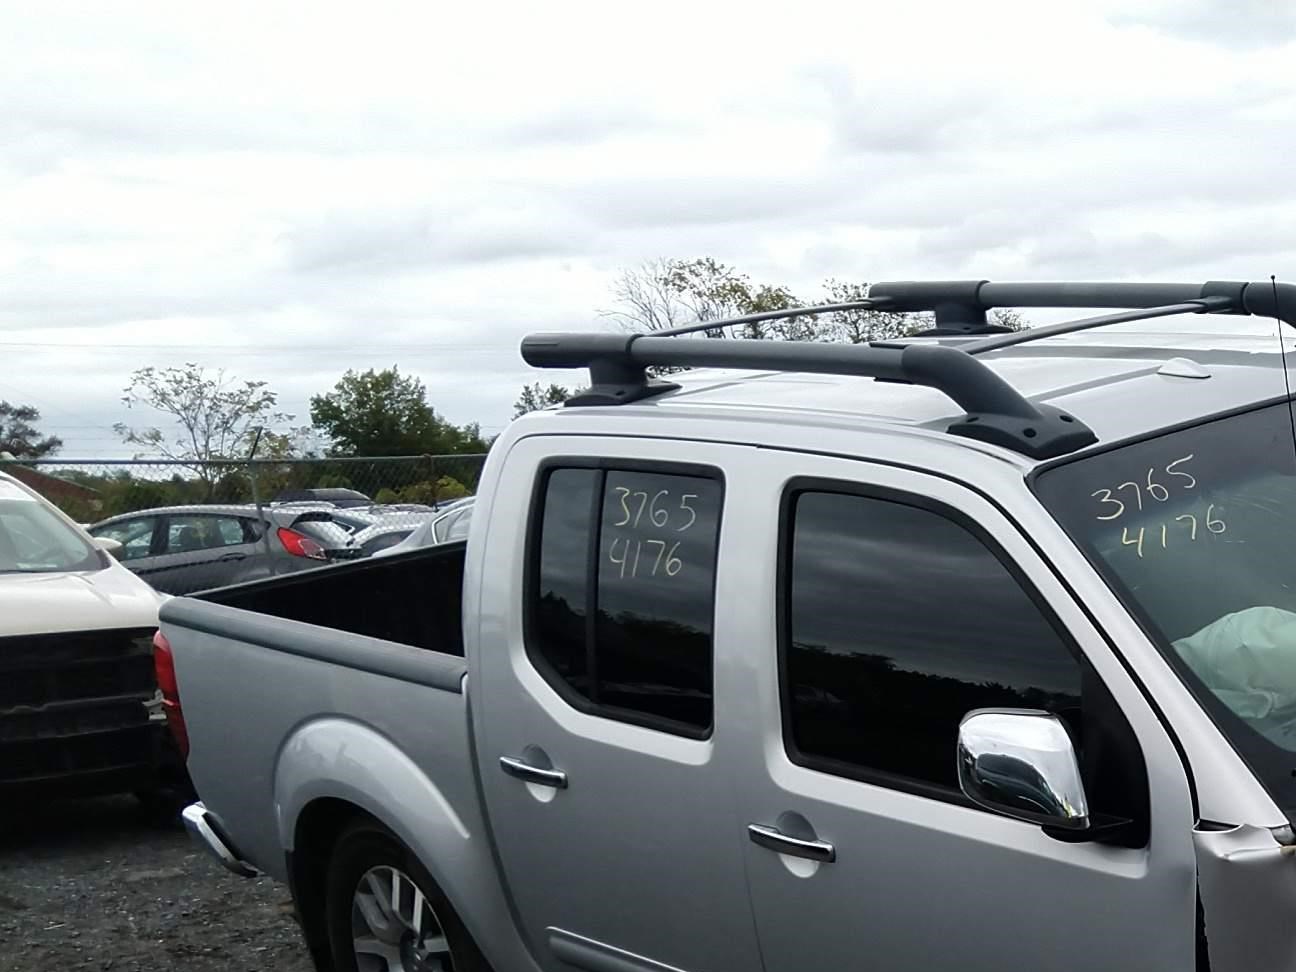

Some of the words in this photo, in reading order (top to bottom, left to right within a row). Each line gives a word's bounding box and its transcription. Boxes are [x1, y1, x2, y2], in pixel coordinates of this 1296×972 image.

[614, 486, 698, 532] 3765
[1090, 453, 1197, 520] 3765
[1121, 503, 1227, 558] 4176
[608, 537, 683, 580] 4176
